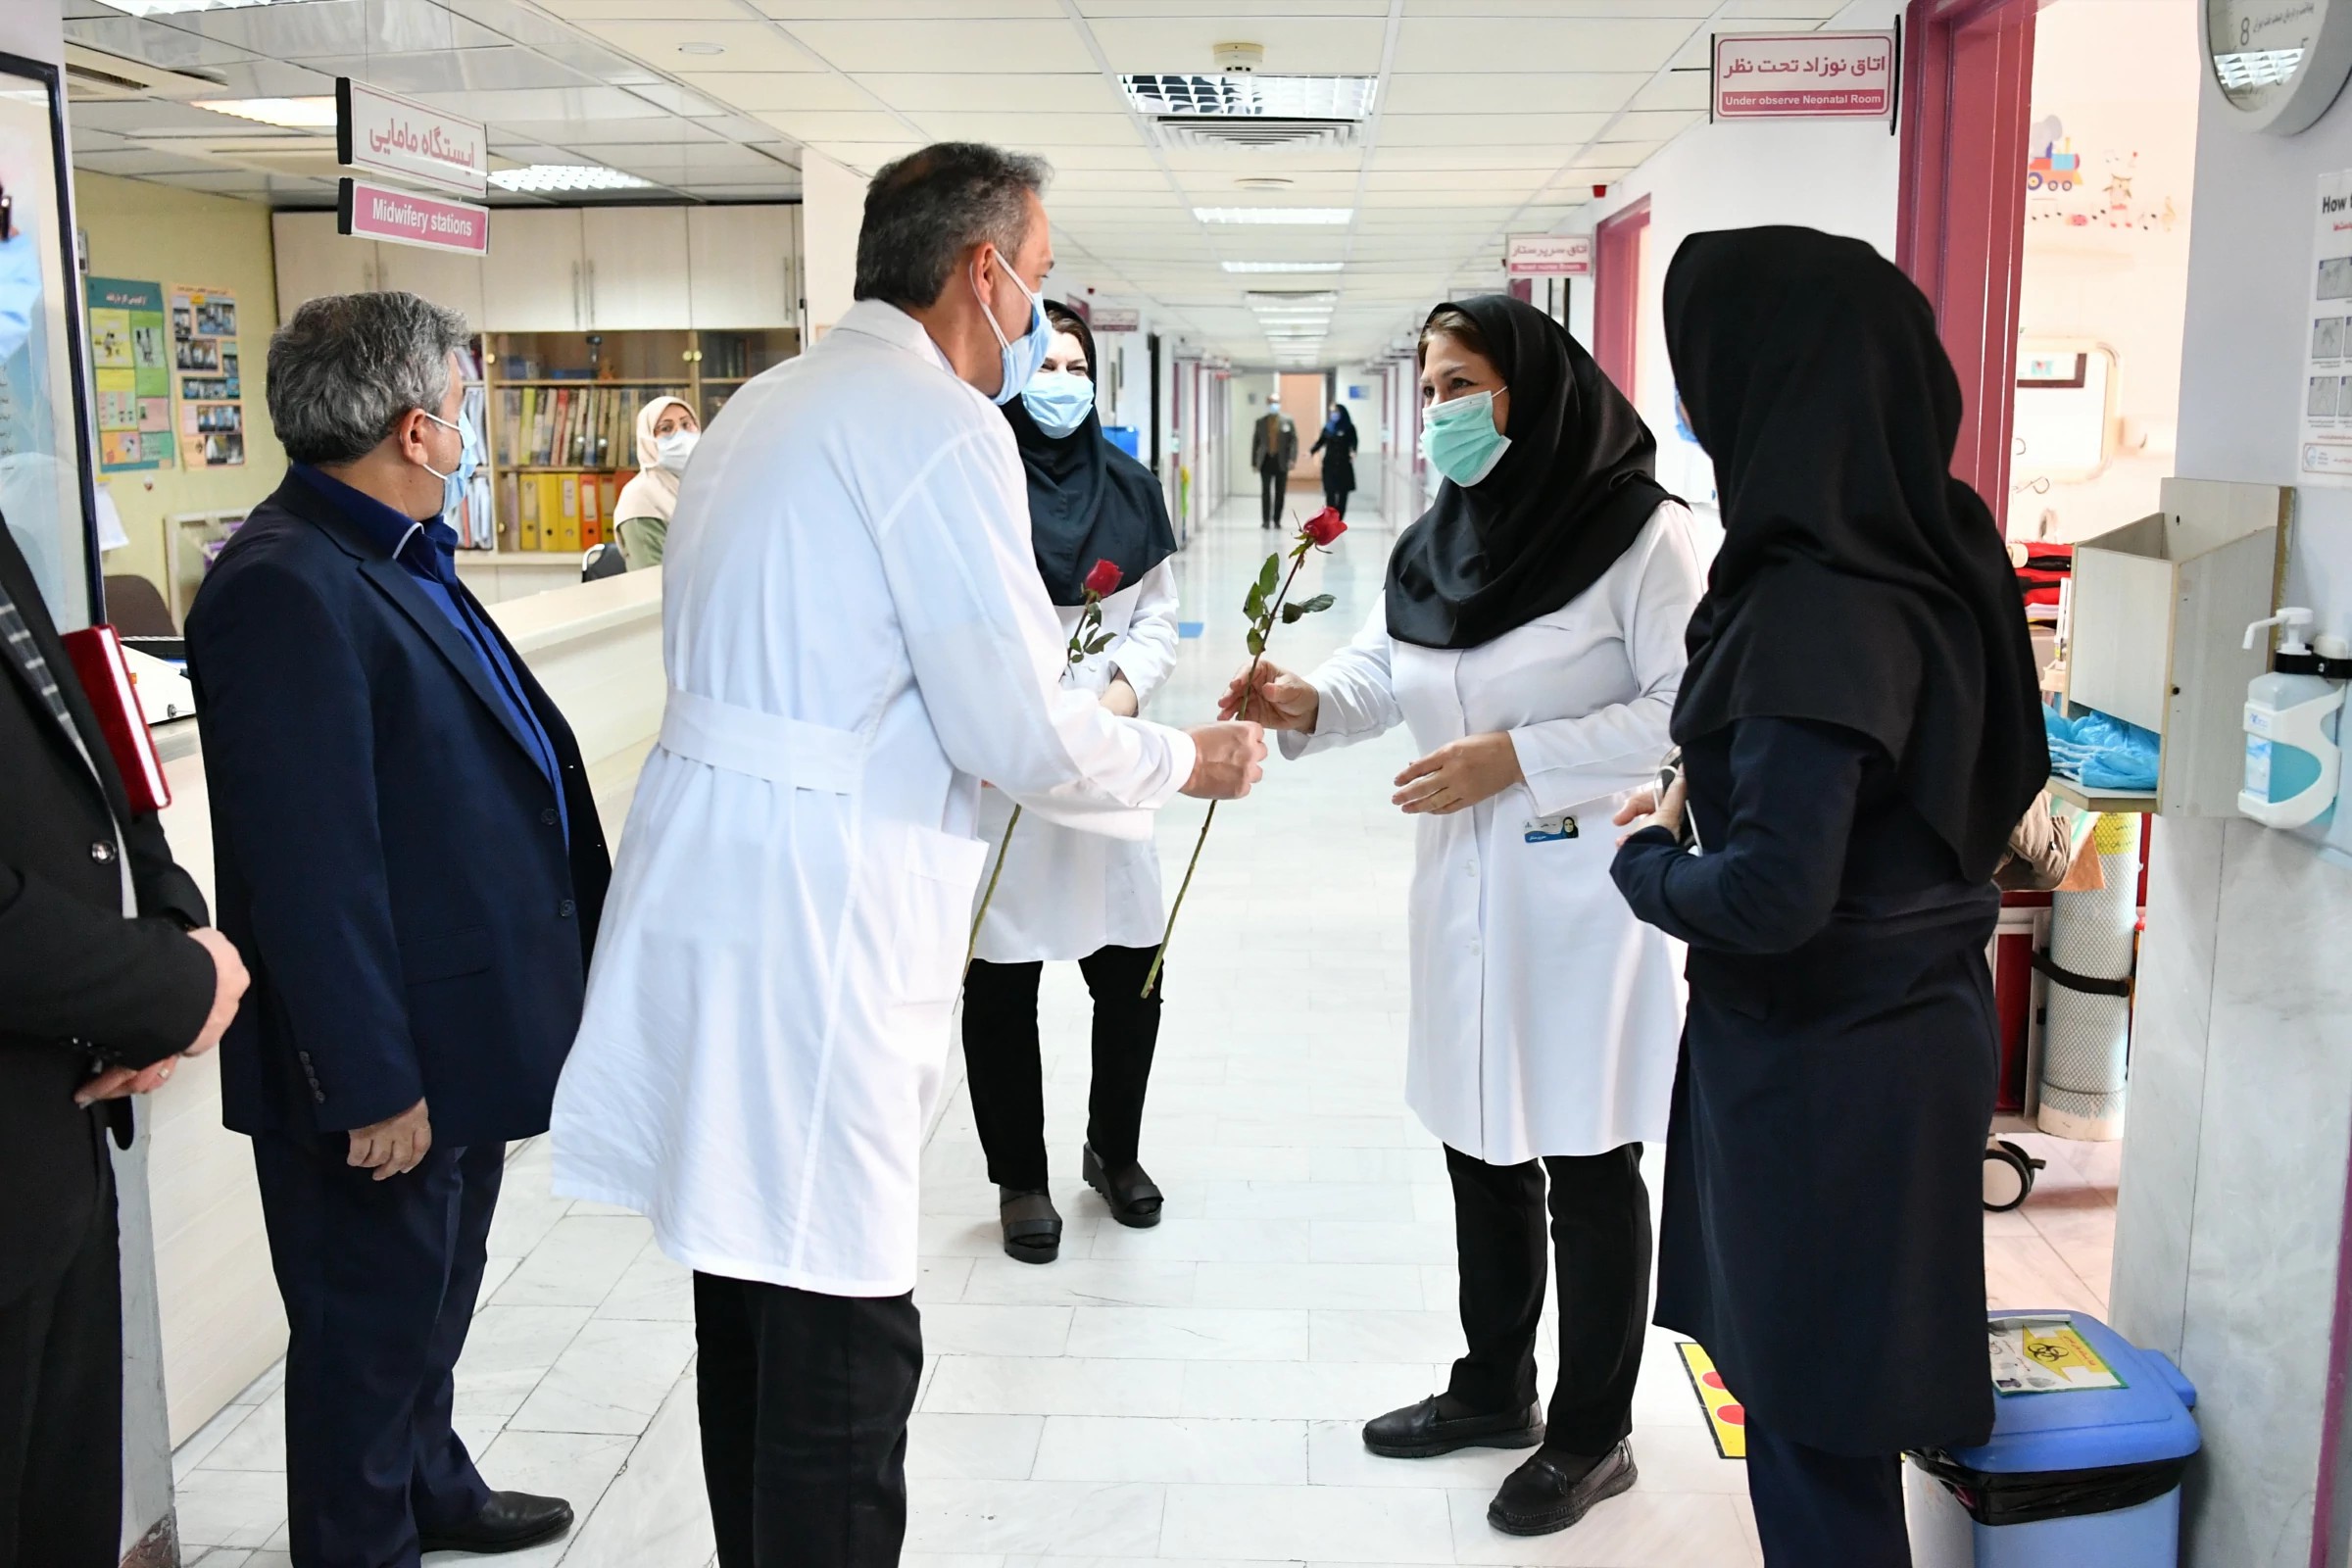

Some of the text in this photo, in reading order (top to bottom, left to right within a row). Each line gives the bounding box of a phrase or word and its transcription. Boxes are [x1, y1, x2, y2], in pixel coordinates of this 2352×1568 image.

[2240, 17, 2250, 46] 8
[1723, 56, 1885, 78] اتاق نوزاد تحت نظر
[1725, 93, 1882, 106] Under observe Neonatal Room
[369, 118, 475, 175] ایستگاه مامایی
[2322, 195, 2348, 215] How
[371, 197, 473, 237] Midwifery stations
[1567, 243, 1588, 257] اتاق
